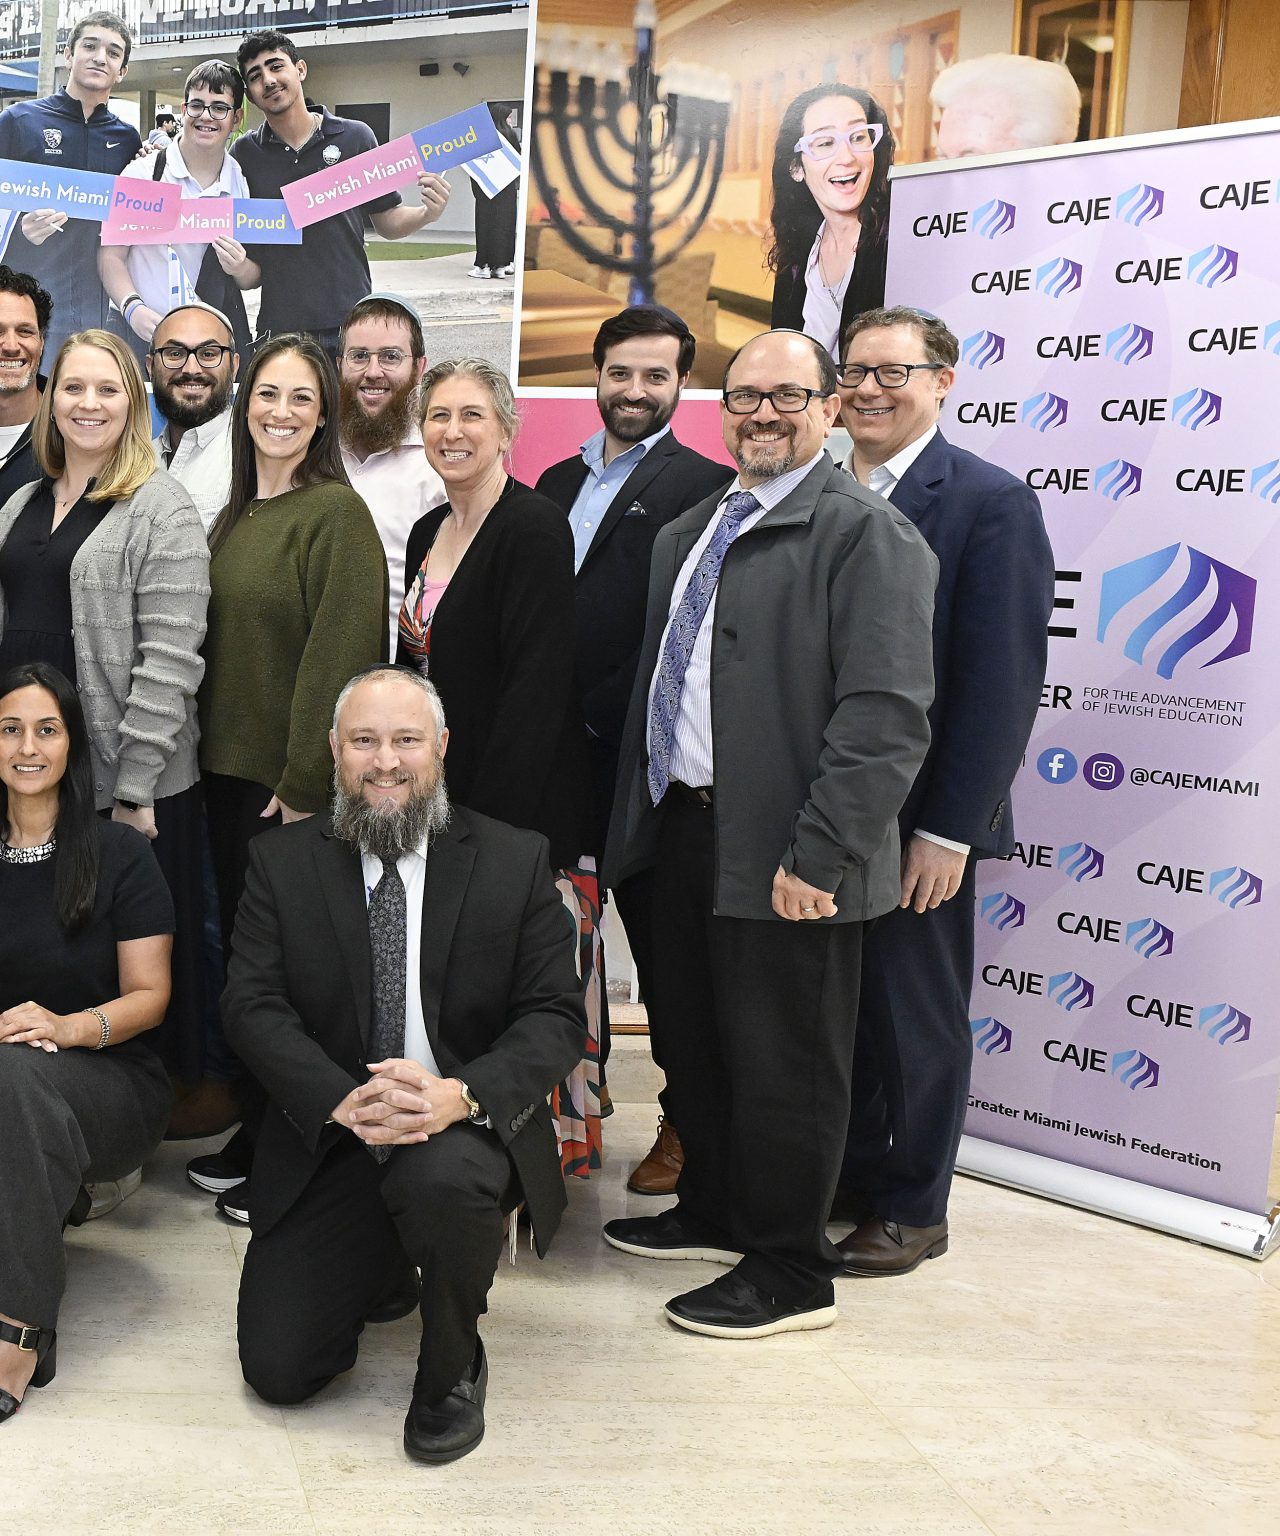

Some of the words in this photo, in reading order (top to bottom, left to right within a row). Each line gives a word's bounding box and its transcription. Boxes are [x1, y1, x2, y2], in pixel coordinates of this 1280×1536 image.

[303, 178, 362, 209] Jewish
[363, 149, 418, 185] Miami
[420, 126, 478, 161] Proud
[56, 183, 109, 206] Miami
[114, 192, 164, 213] Proud
[1199, 180, 1272, 212] CAJE
[180, 213, 230, 229] Miami
[236, 213, 286, 230] Proud
[912, 211, 968, 239] CAJE
[1047, 197, 1111, 226] CAJE
[970, 268, 1032, 296] CAJE
[1115, 257, 1182, 286] CAJE
[1036, 334, 1101, 362] CAJE
[1188, 326, 1258, 356] CAJE
[957, 402, 1018, 428] CAJE
[1101, 398, 1167, 425] CAJE
[1026, 468, 1090, 494] CAJE
[1176, 468, 1246, 496] CAJE
[1082, 700, 1100, 712] OF
[1103, 702, 1154, 719] JEWISH
[1158, 708, 1243, 727] EDUCATION
[1083, 686, 1109, 700] FOR
[1112, 689, 1138, 703] THE
[1140, 692, 1246, 713] ADVANCEMENT
[1130, 768, 1260, 798] @CAJEMIAMI
[1136, 862, 1205, 894] CAJE
[1057, 911, 1122, 943] CAJE
[982, 964, 1044, 996] CAJE
[1126, 994, 1195, 1029] CAJE
[1043, 1040, 1108, 1073] CAJE
[1023, 1109, 1071, 1133] Miami
[1074, 1121, 1126, 1148] Jewish
[1131, 1136, 1222, 1172] Federation
